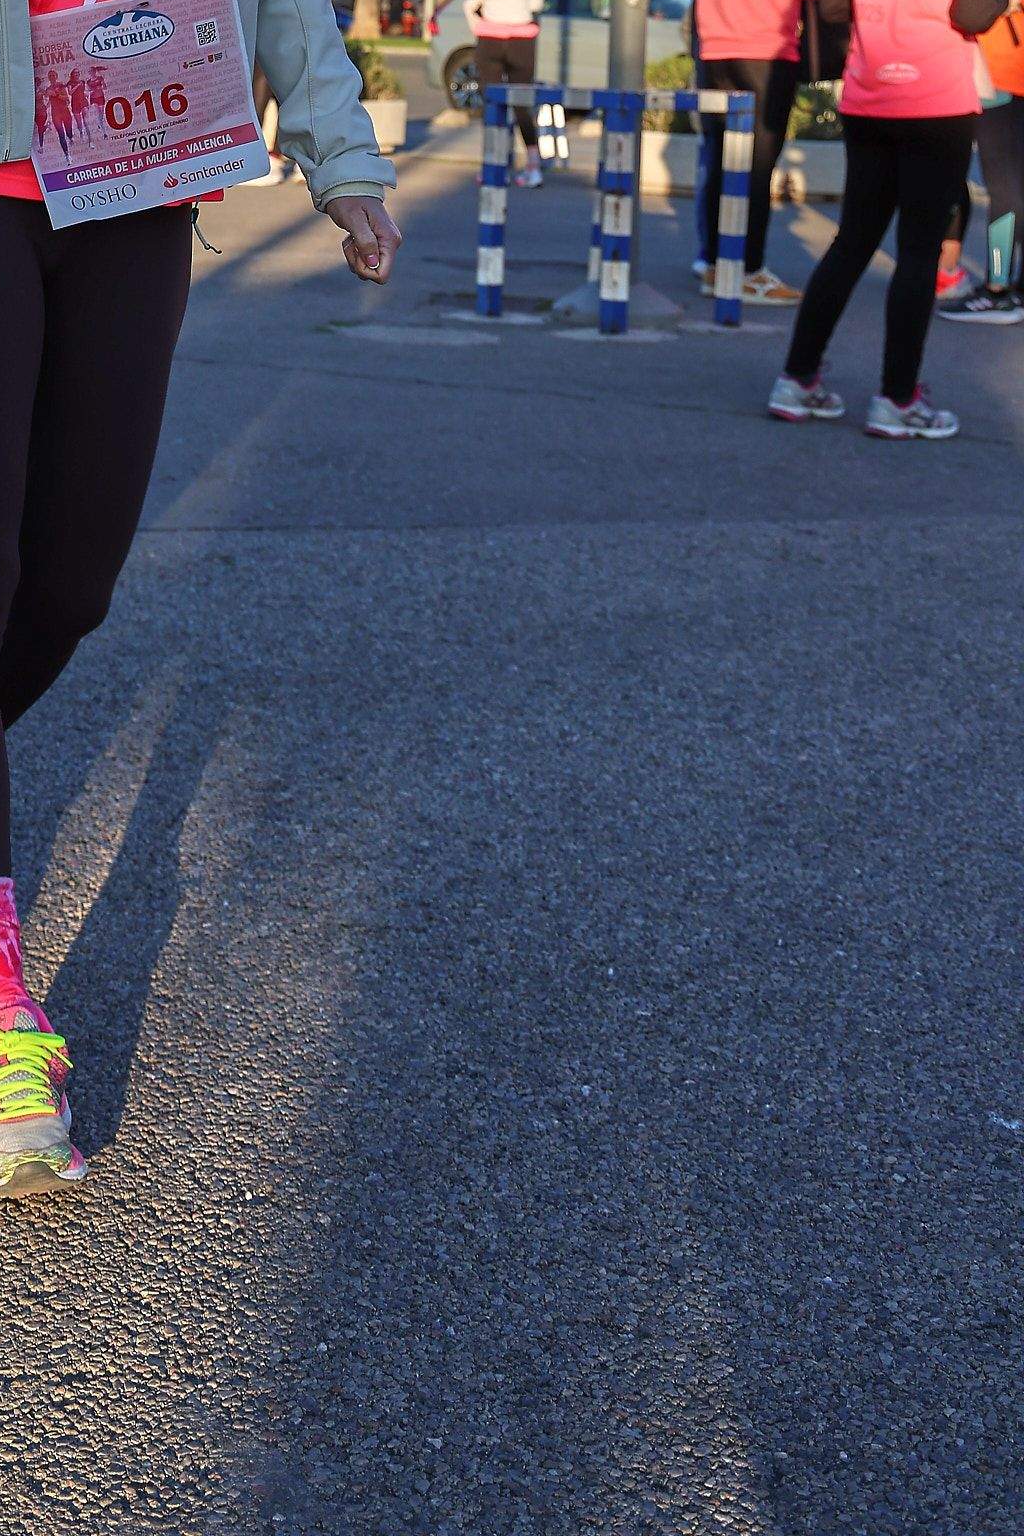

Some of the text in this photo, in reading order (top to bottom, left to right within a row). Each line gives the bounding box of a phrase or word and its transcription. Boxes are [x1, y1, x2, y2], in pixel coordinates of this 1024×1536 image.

[91, 25, 169, 53] ASTURIANA
[103, 19, 163, 37] CENTRAL LECHERA
[39, 41, 73, 54] DORSAL
[105, 83, 189, 130] 016
[128, 131, 167, 152] 7007
[66, 134, 234, 184] CARRERA DE LA MUJER VALENCIA
[70, 158, 245, 211] OYSHO Santander
